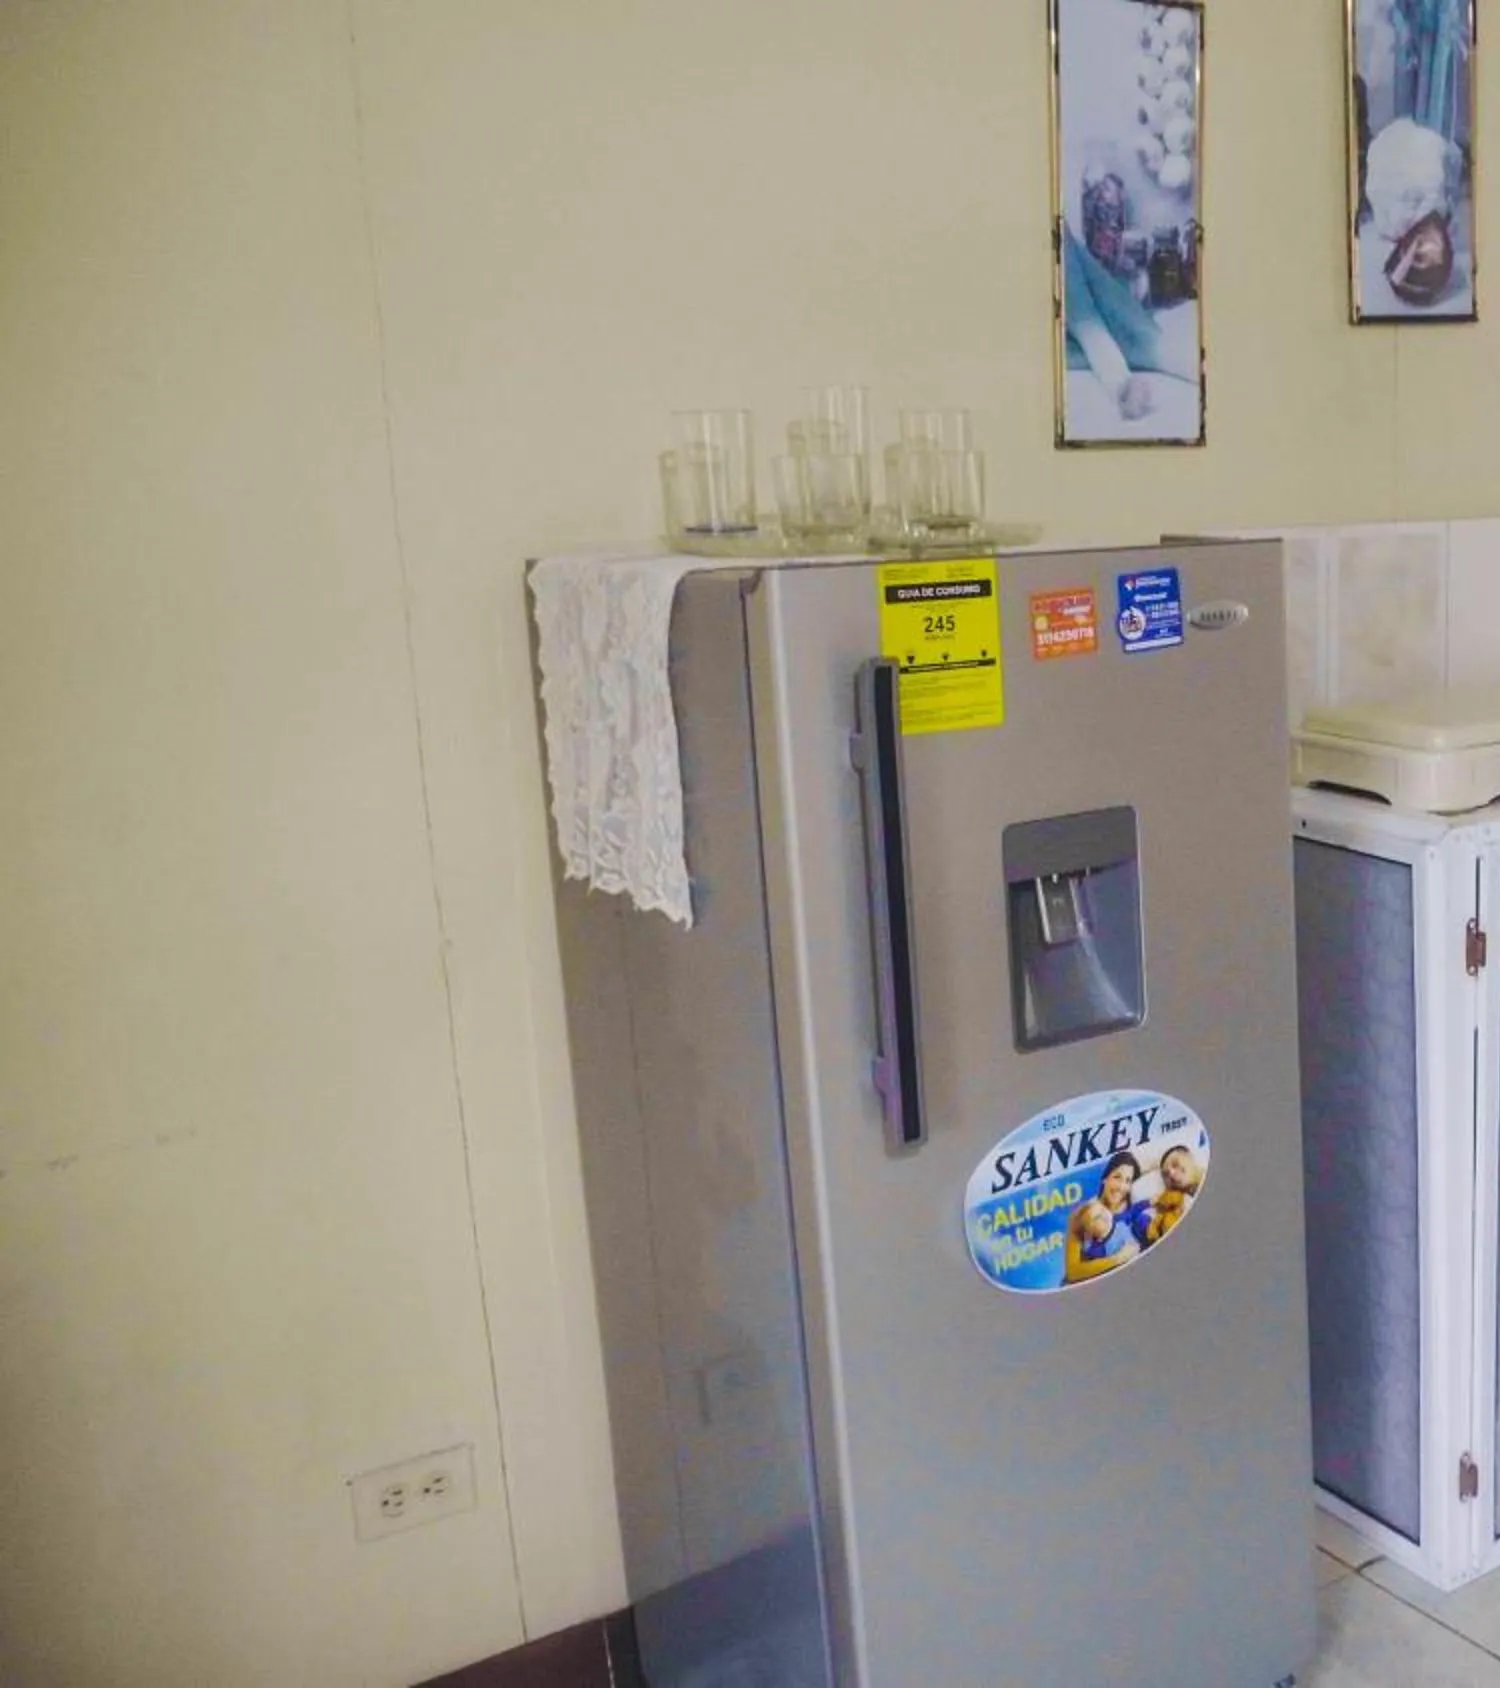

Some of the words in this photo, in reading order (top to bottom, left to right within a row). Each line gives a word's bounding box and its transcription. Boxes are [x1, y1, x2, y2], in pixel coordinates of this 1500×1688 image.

[921, 587, 935, 597] DE
[924, 615, 956, 633] 245
[1043, 1114, 1065, 1132] ECO
[991, 1104, 1160, 1194] SANKEY
[975, 1183, 1083, 1241] CALIDAD
[993, 1231, 1065, 1277] HOGAR
